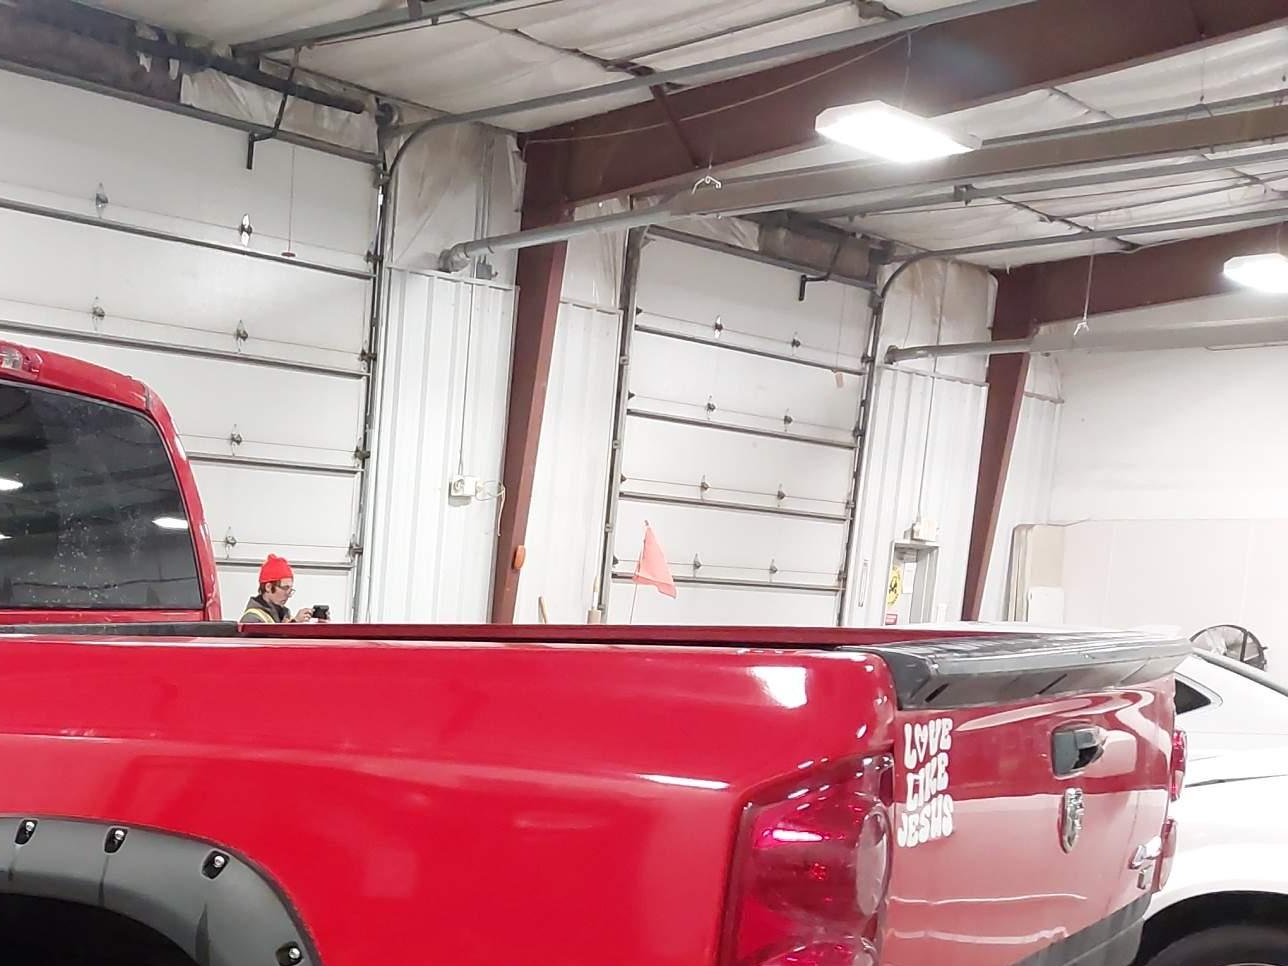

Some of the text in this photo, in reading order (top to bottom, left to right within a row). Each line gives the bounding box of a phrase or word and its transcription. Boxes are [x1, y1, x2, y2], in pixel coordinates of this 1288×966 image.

[904, 718, 953, 768] LOVE
[907, 753, 949, 812] LIKE
[897, 795, 953, 847] JESUS
